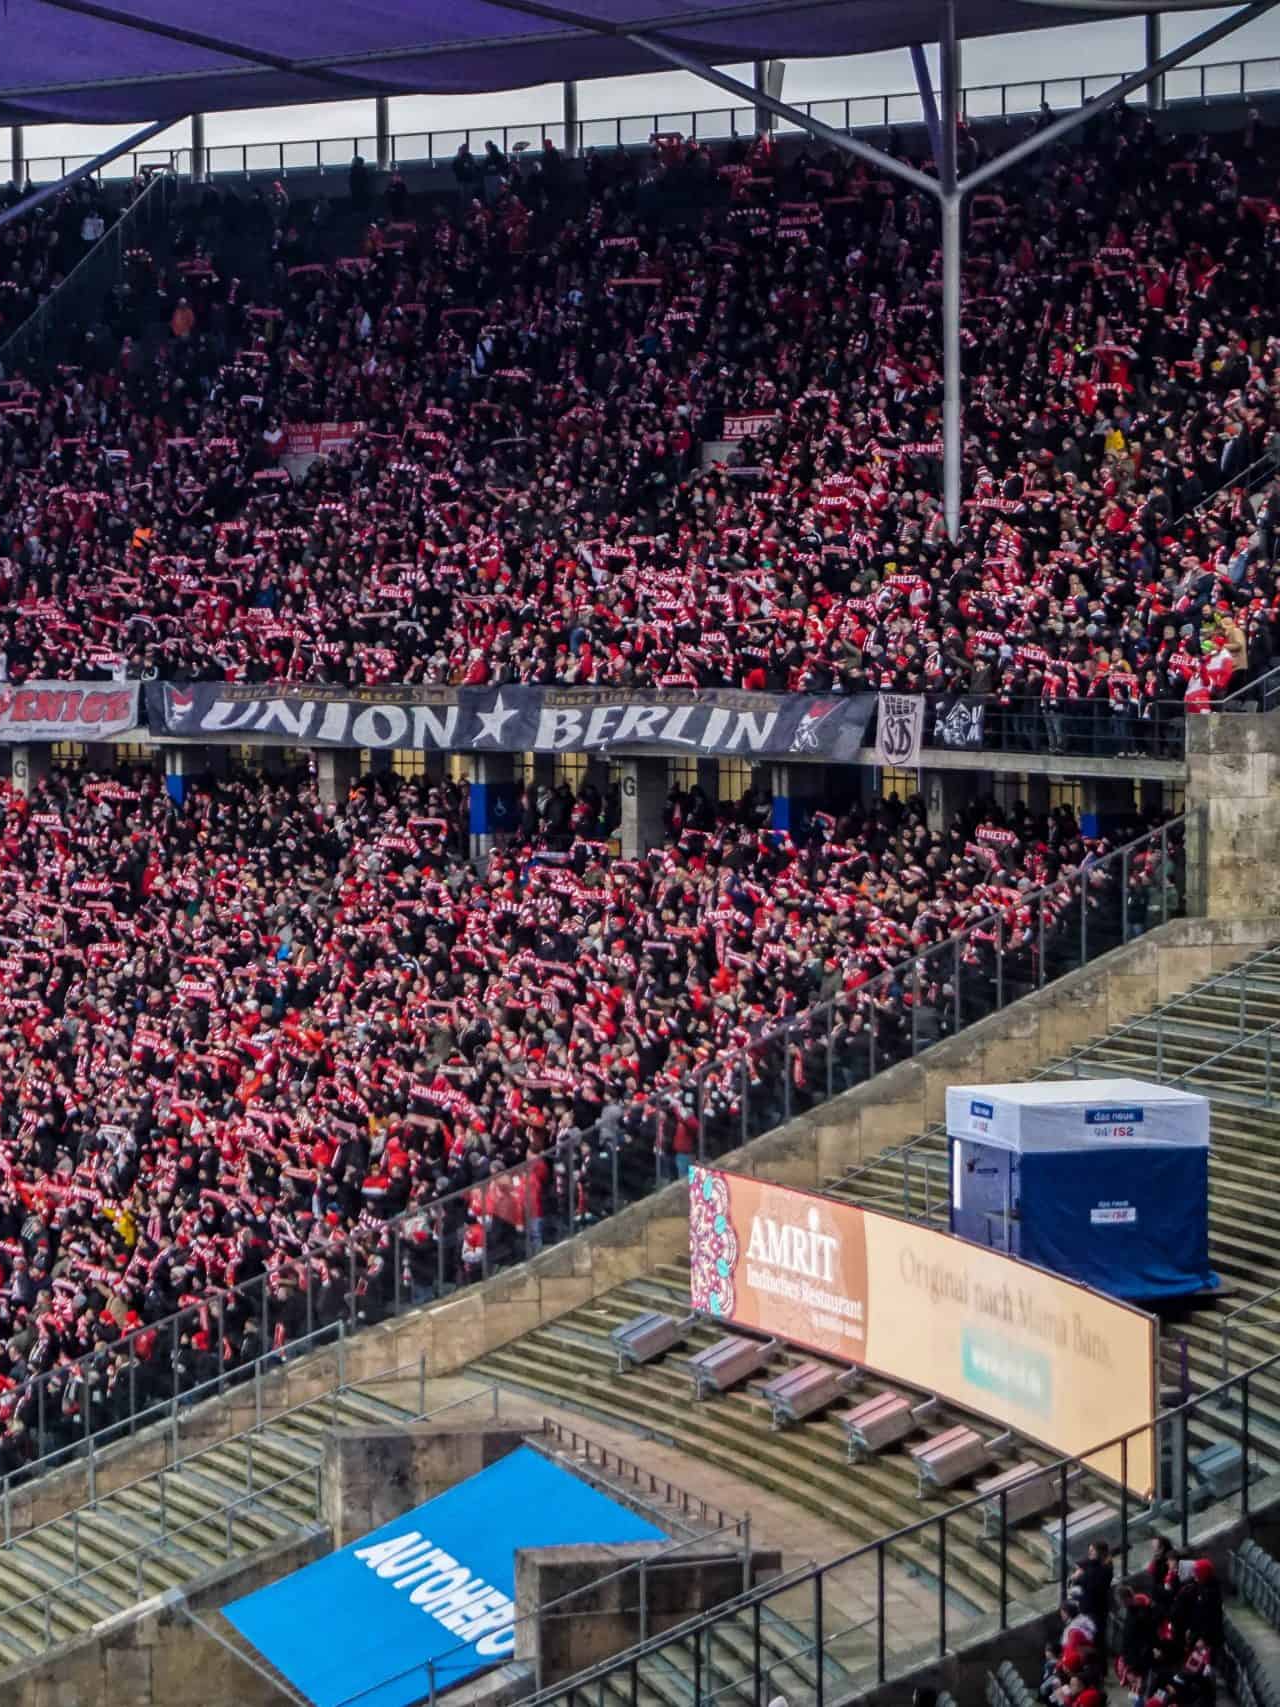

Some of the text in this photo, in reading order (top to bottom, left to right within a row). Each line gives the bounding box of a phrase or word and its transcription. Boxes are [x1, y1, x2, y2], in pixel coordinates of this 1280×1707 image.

[201, 700, 781, 752] UNION BERLIN
[14, 760, 26, 778] G
[623, 776, 636, 797] G
[975, 828, 1015, 842] UNION
[746, 1214, 839, 1282] AMRIT
[900, 1247, 969, 1306] Original
[354, 1530, 516, 1656] AUTOHERO
